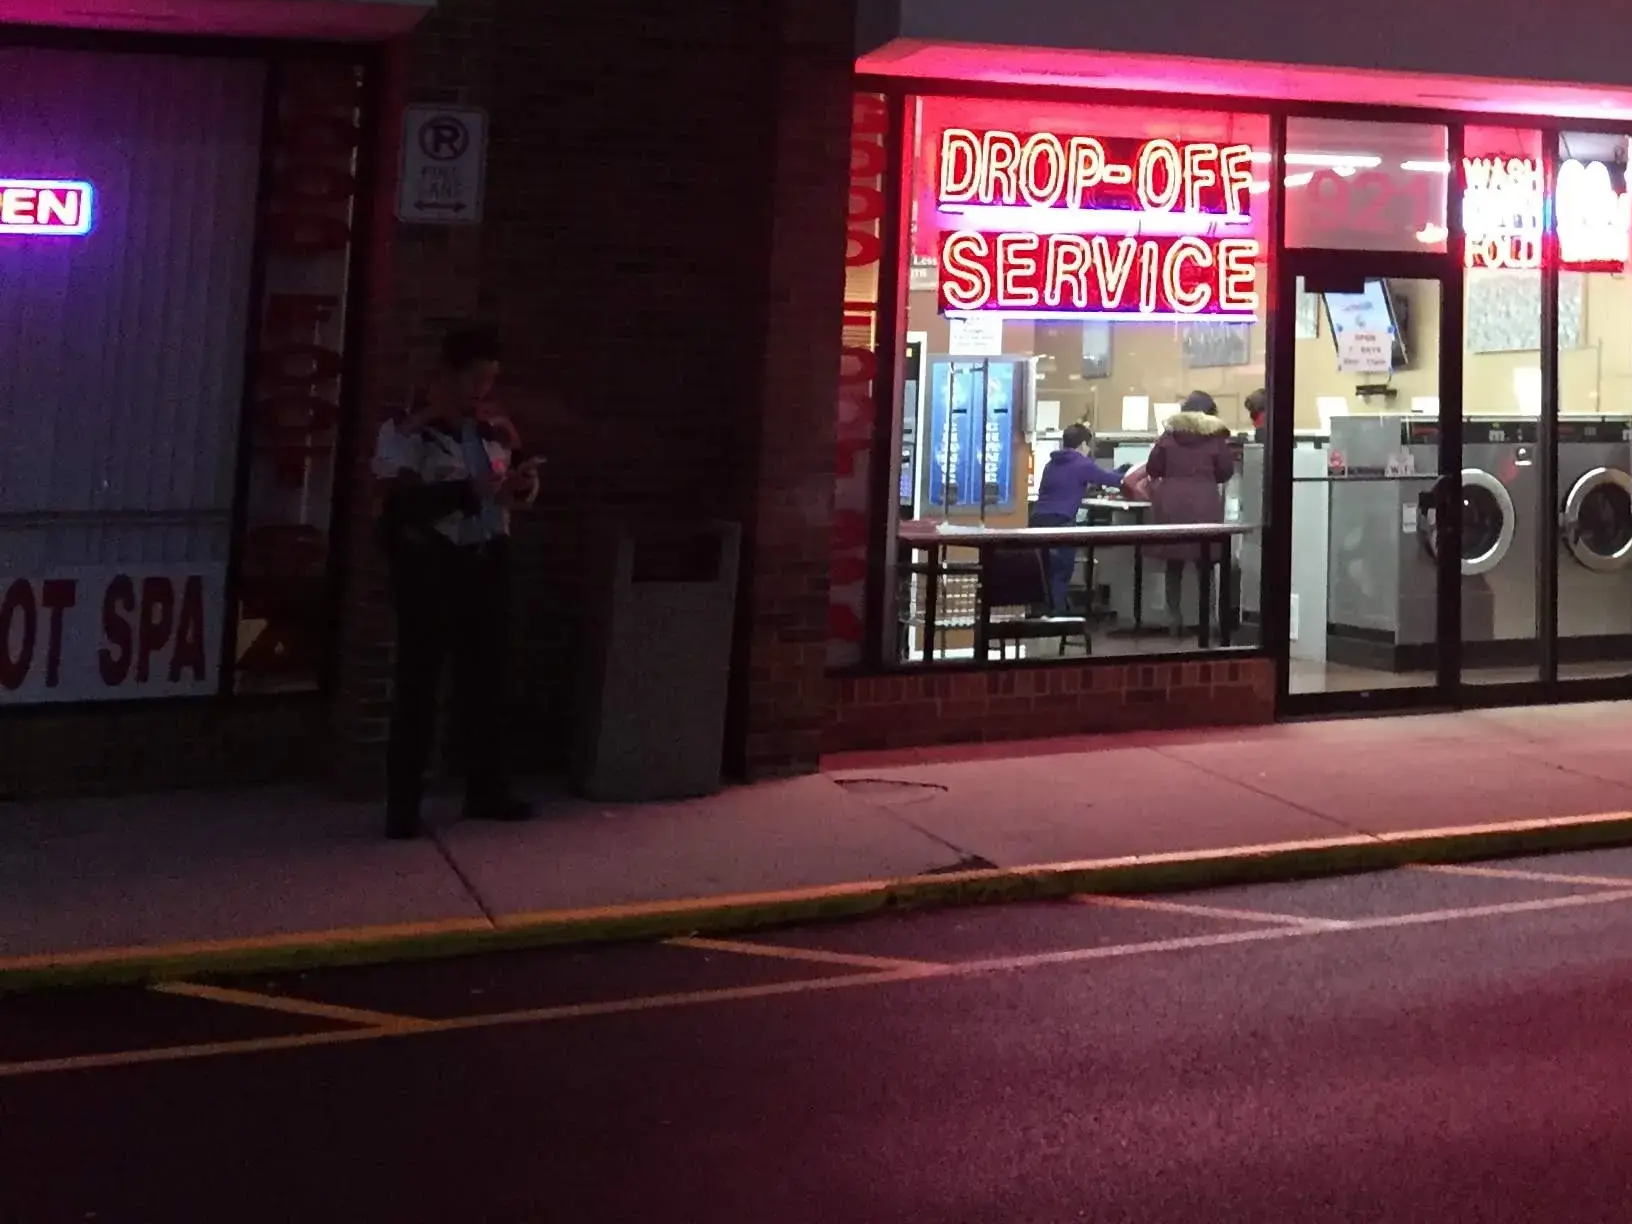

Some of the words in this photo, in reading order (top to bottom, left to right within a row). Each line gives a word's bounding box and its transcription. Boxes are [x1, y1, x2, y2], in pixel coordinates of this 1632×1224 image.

[939, 128, 1255, 216] DROP-OFF
[1307, 169, 1430, 232] 921
[942, 230, 1259, 313] SERVICE
[1464, 231, 1542, 269] FOLD
[98, 573, 206, 686] SPA
